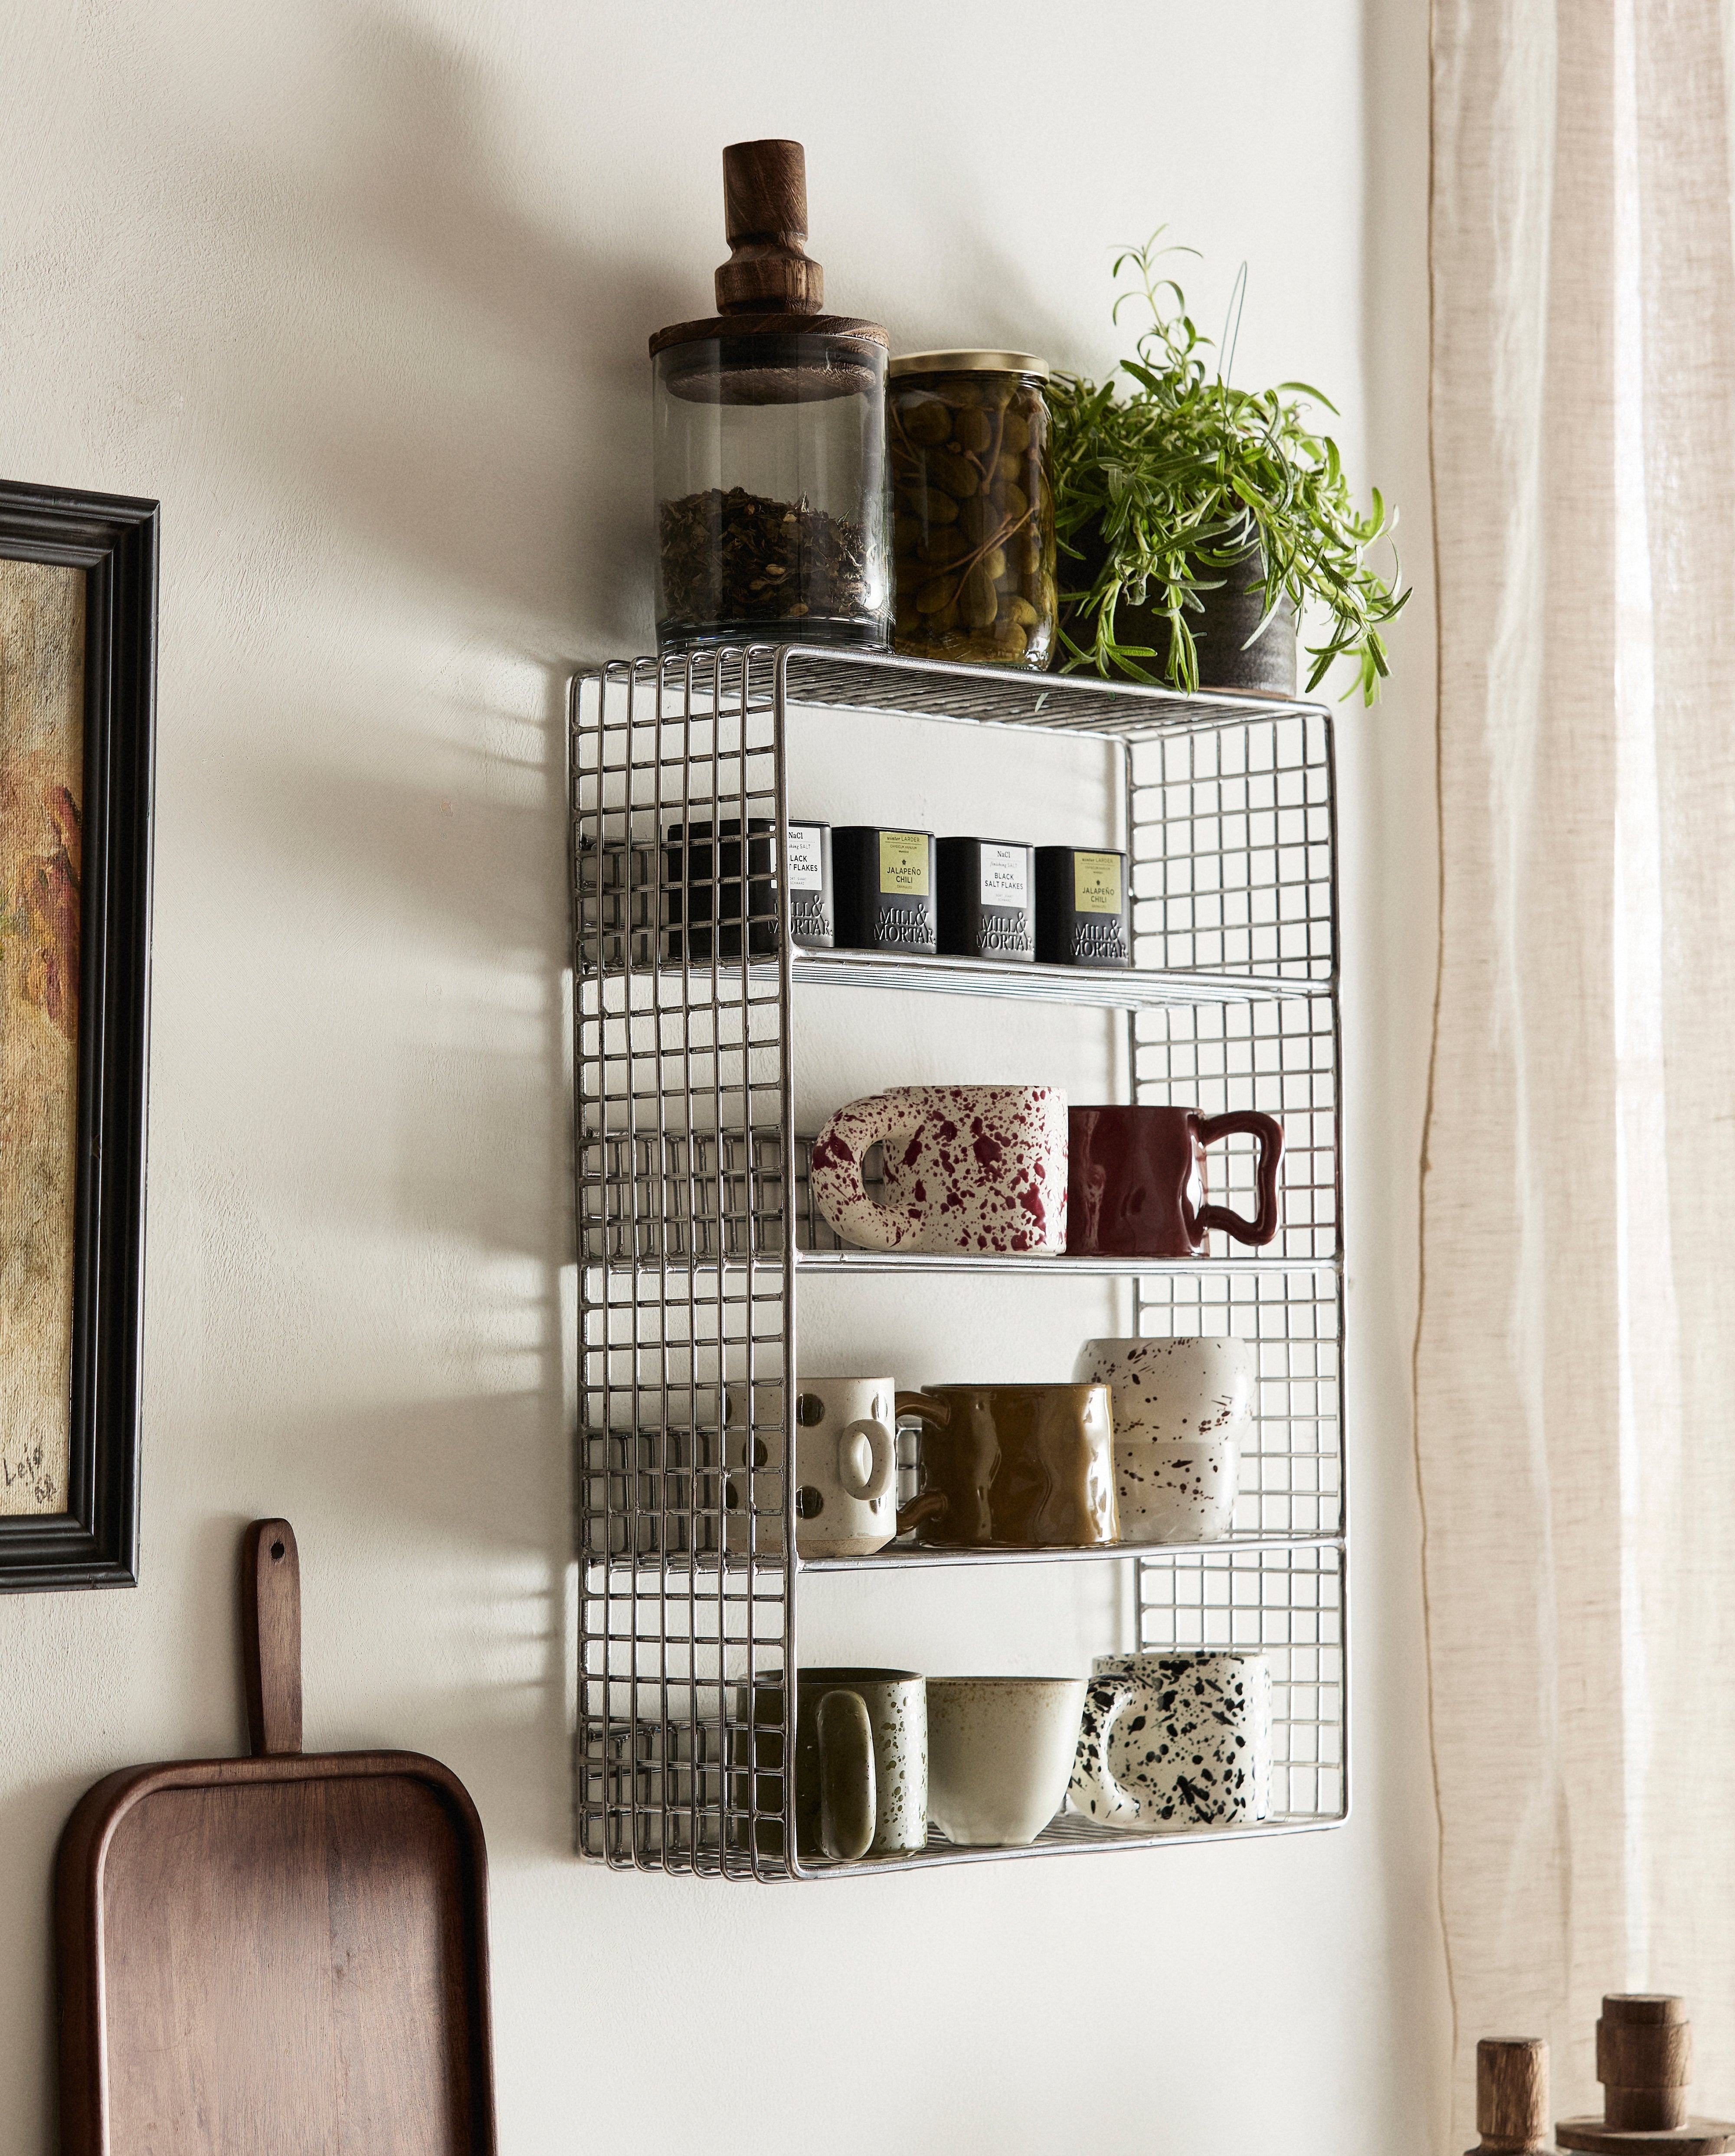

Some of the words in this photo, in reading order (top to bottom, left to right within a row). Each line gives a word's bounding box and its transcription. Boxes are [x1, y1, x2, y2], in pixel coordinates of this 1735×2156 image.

[887, 867, 921, 875] JALAPEÑO
[1083, 887, 1114, 895] JALAPEÑO
[874, 924, 936, 945] MORTAR
[976, 931, 1034, 953] MORTAR
[1070, 940, 1129, 959] MORTAR
